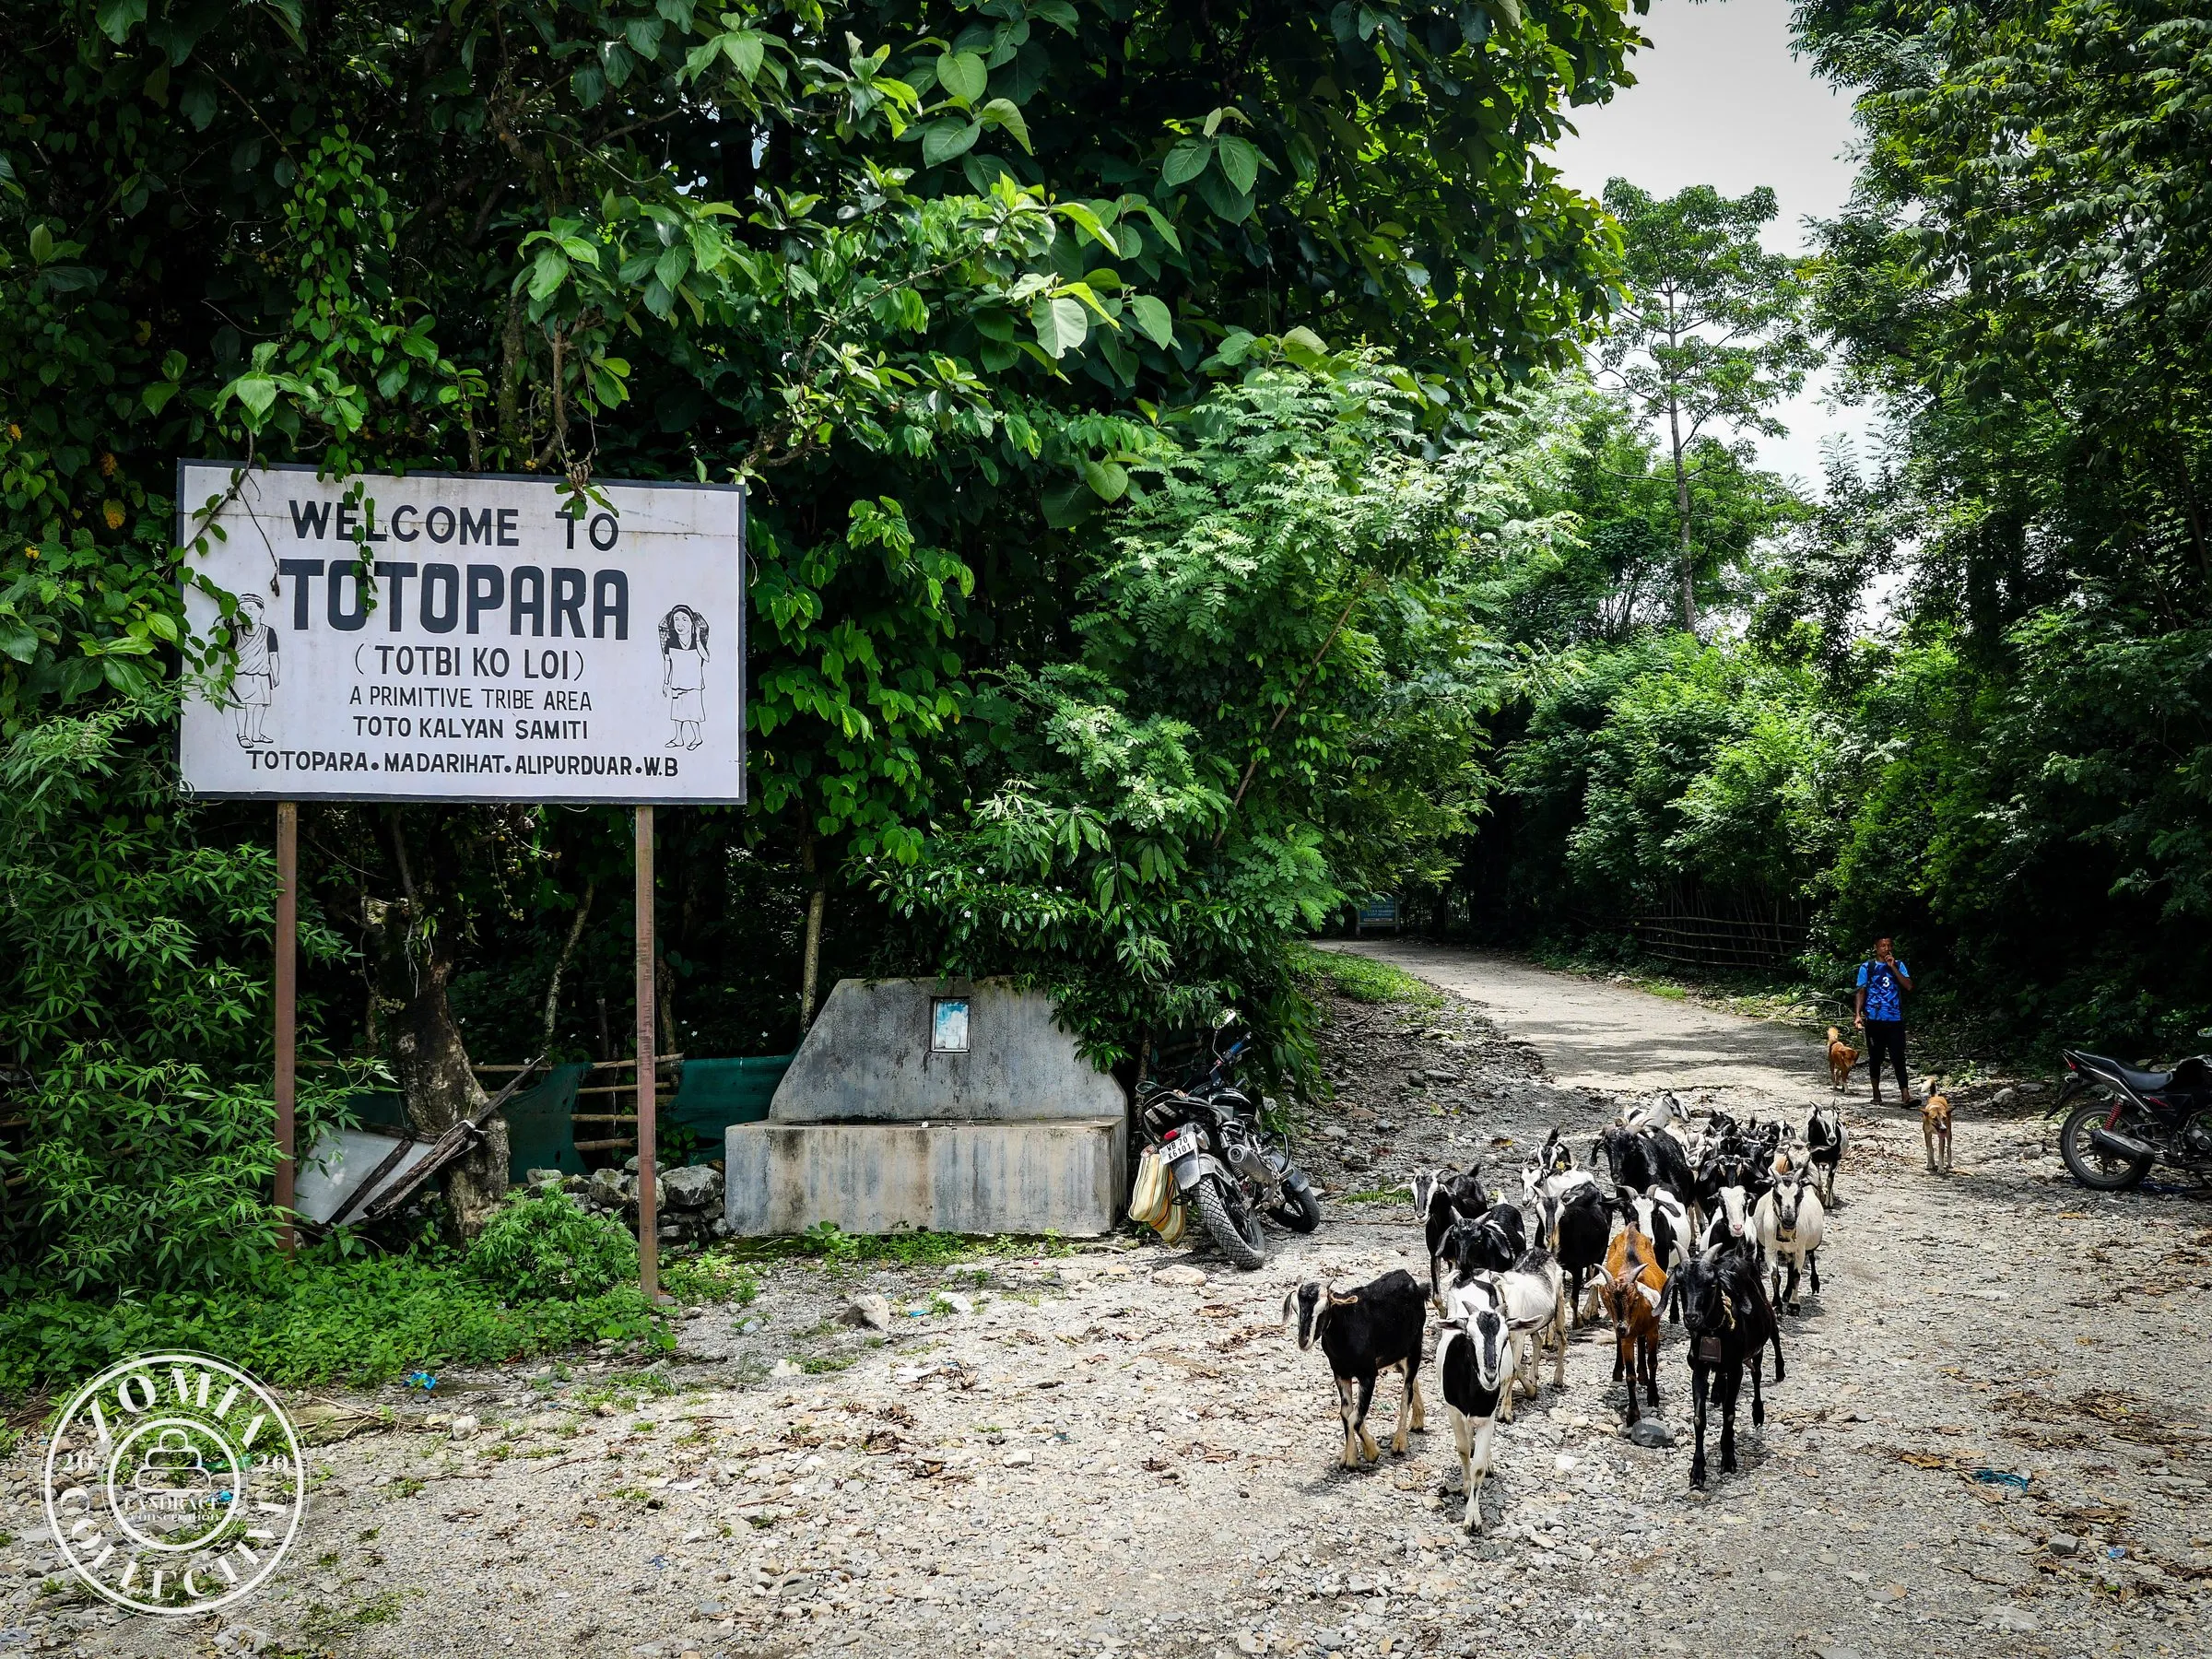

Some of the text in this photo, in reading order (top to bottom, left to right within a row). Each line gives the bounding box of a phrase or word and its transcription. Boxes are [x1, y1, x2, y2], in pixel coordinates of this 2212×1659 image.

[288, 500, 618, 551] WELCOME TO
[279, 559, 629, 641] TOTOPARA
[473, 647, 510, 677] KO
[524, 649, 583, 681] LOI)
[349, 686, 592, 711] A PRIMITIVE TRIBE AREA
[353, 716, 587, 740] TOTO KALYAN SAMITI
[1882, 976, 1890, 988] 3
[1167, 1135, 1188, 1152] WB 70
